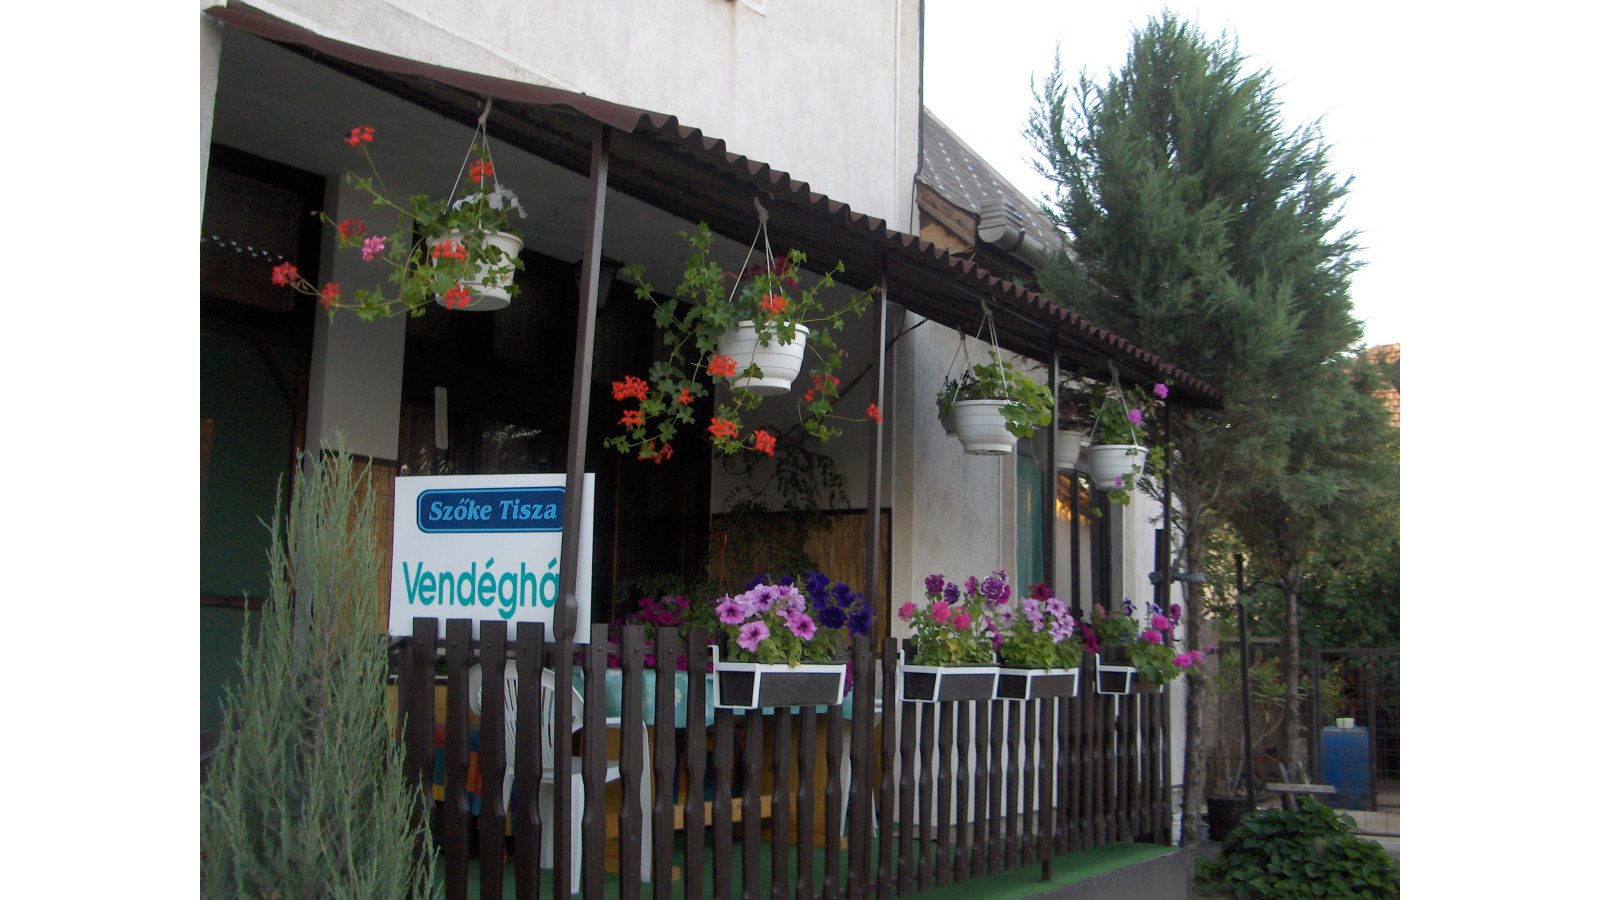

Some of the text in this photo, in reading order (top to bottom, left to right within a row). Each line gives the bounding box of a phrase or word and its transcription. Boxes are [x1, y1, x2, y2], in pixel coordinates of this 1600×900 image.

[428, 498, 558, 521] Szőke Tisza
[402, 557, 560, 620] Vendéghá
